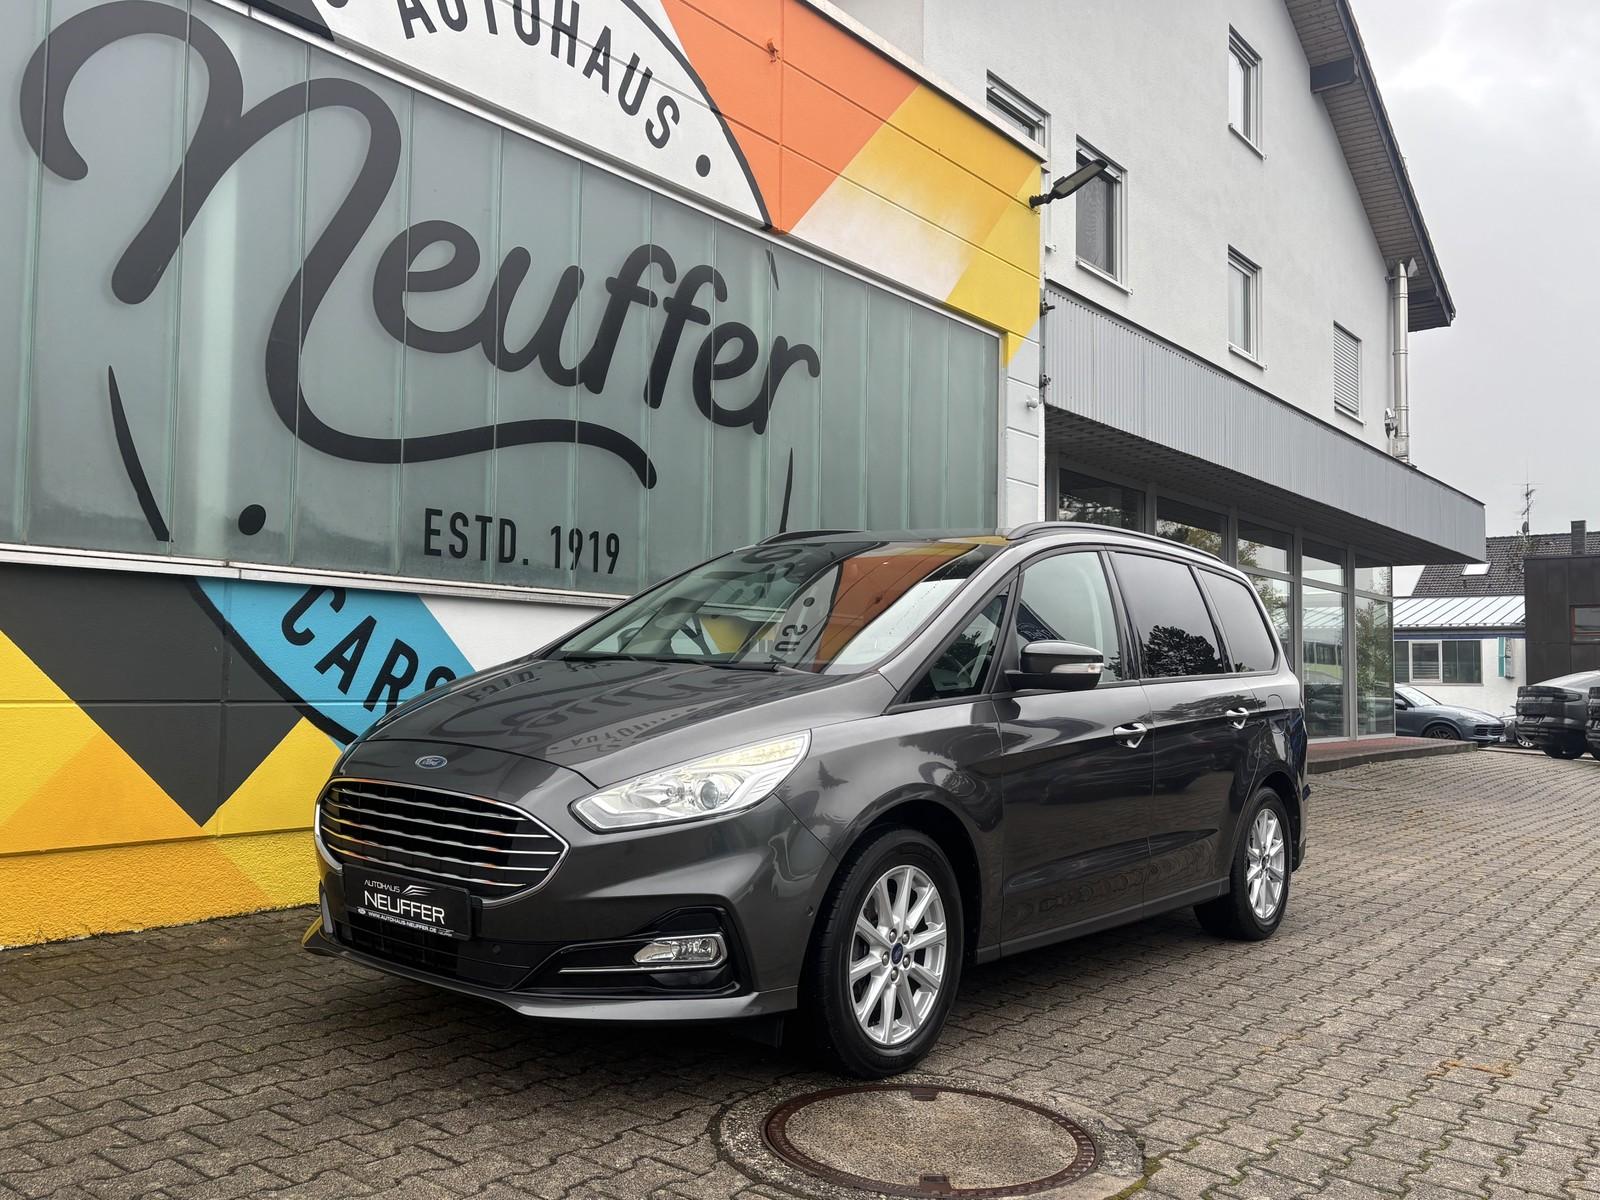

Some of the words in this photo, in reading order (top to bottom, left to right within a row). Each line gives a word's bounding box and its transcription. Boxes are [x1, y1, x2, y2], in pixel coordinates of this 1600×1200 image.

[424, 507, 529, 566] ESTD.
[550, 525, 620, 574] 1919
[364, 879, 401, 894] AUTOHAUS
[364, 890, 445, 925] NEUFFER
